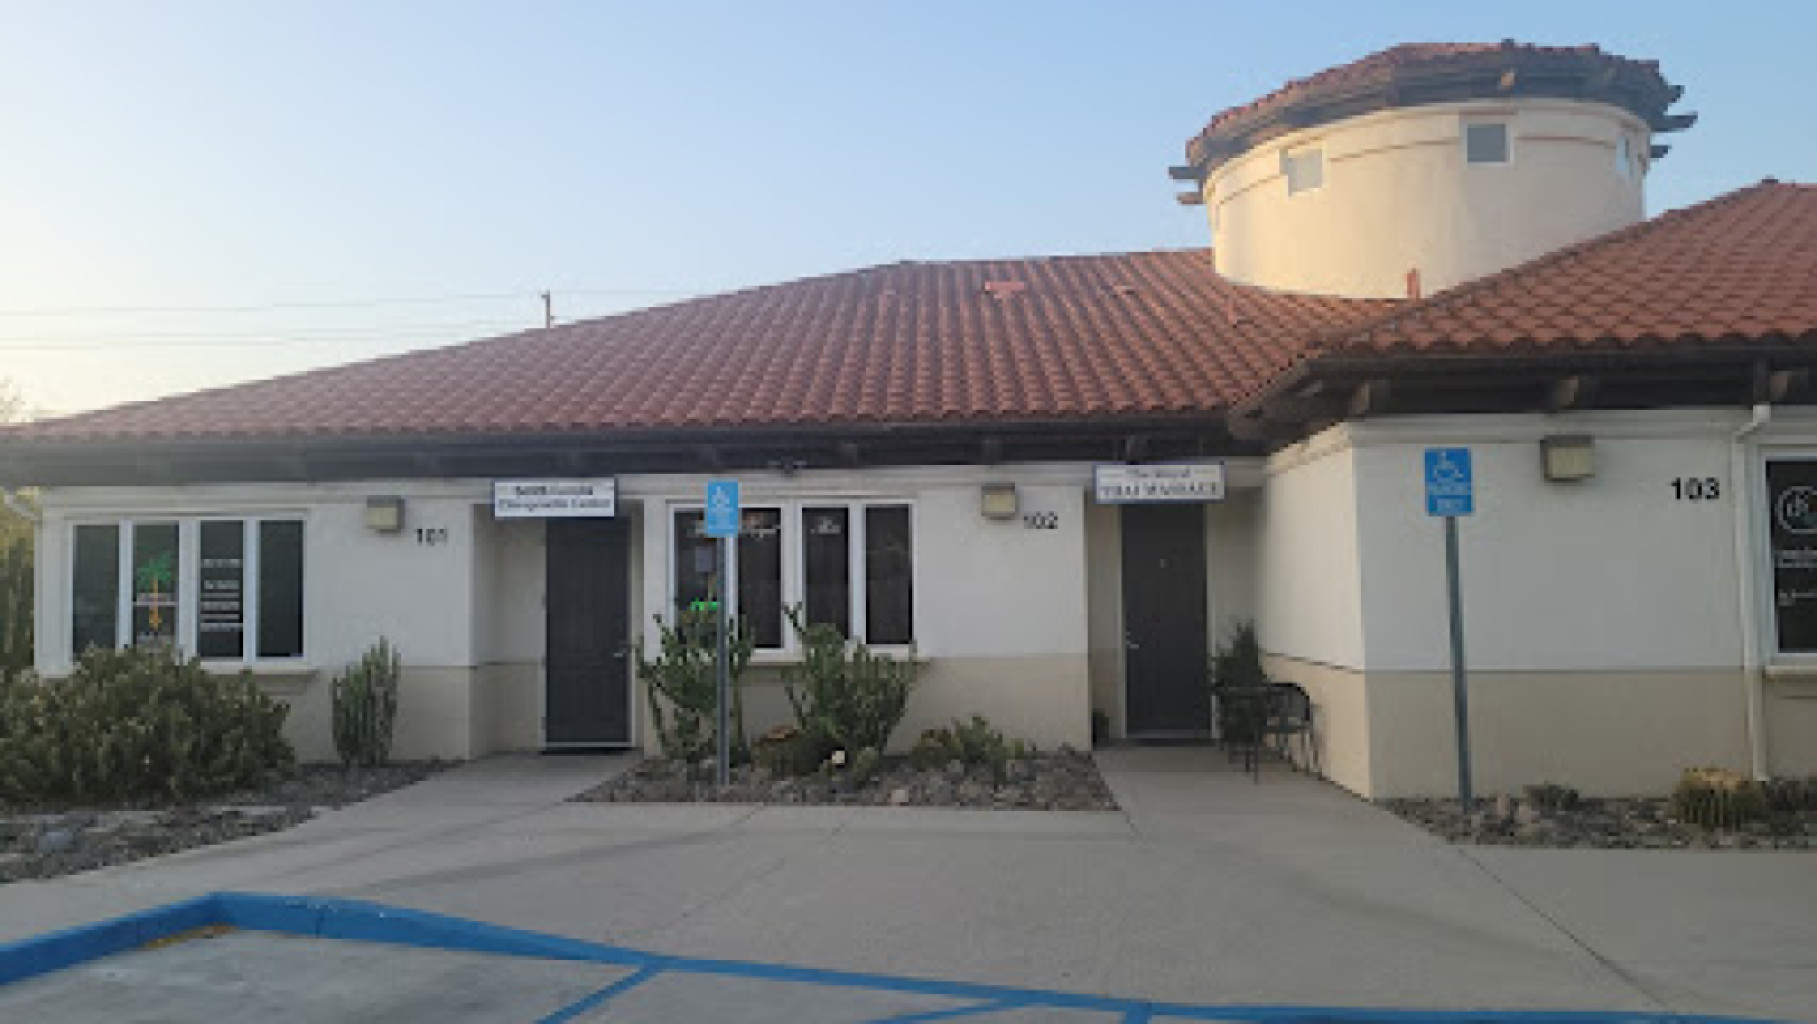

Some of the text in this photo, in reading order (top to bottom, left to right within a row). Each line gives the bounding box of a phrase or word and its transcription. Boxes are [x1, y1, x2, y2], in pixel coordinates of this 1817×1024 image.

[1671, 477, 1719, 500] 103
[1022, 511, 1058, 529] 102
[414, 527, 448, 546] 101
